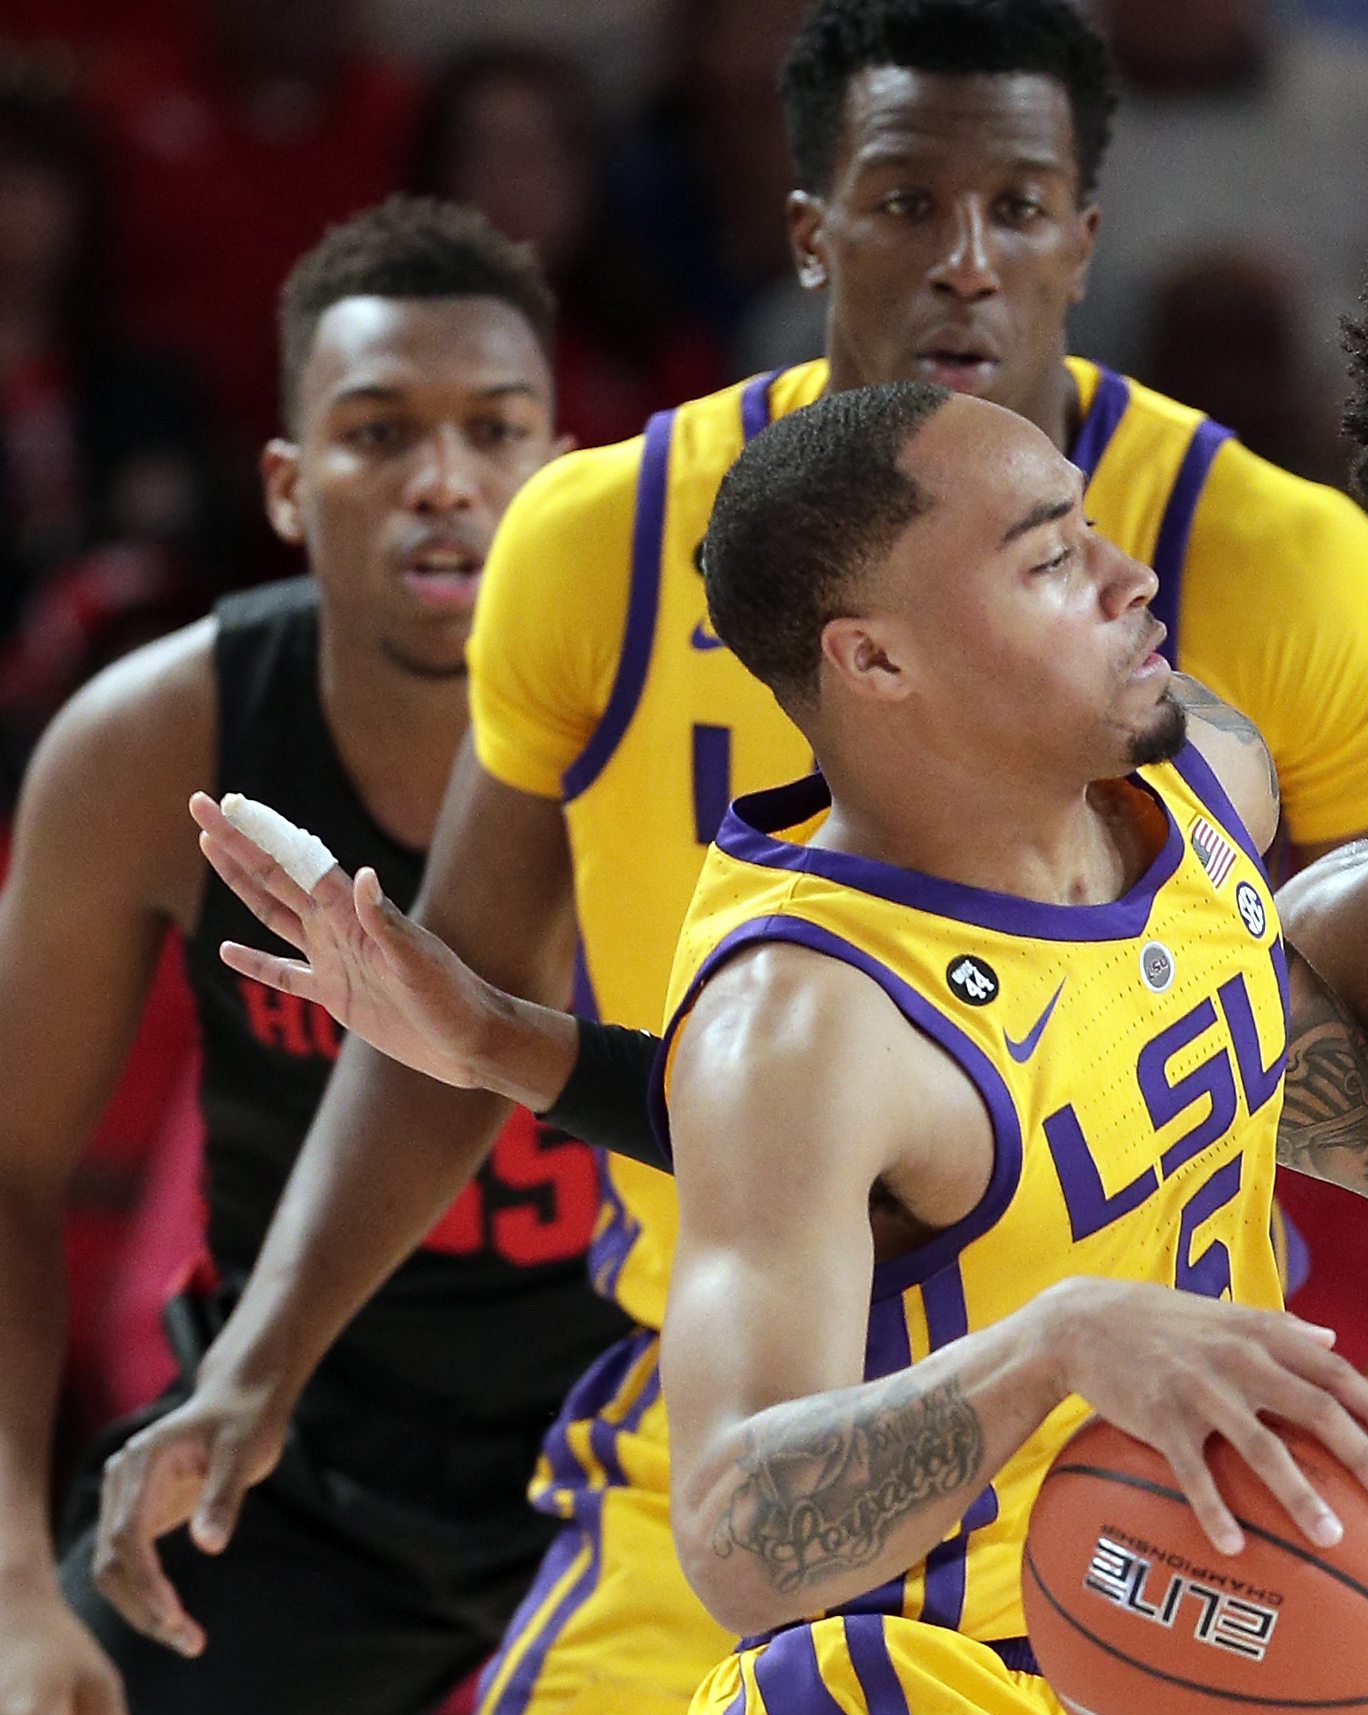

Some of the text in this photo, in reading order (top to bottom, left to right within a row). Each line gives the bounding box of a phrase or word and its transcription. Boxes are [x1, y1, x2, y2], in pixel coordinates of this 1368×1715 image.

[965, 965, 995, 1000] 44
[1042, 932, 1289, 1244] LSU
[1083, 1536, 1280, 1663] ELITE
